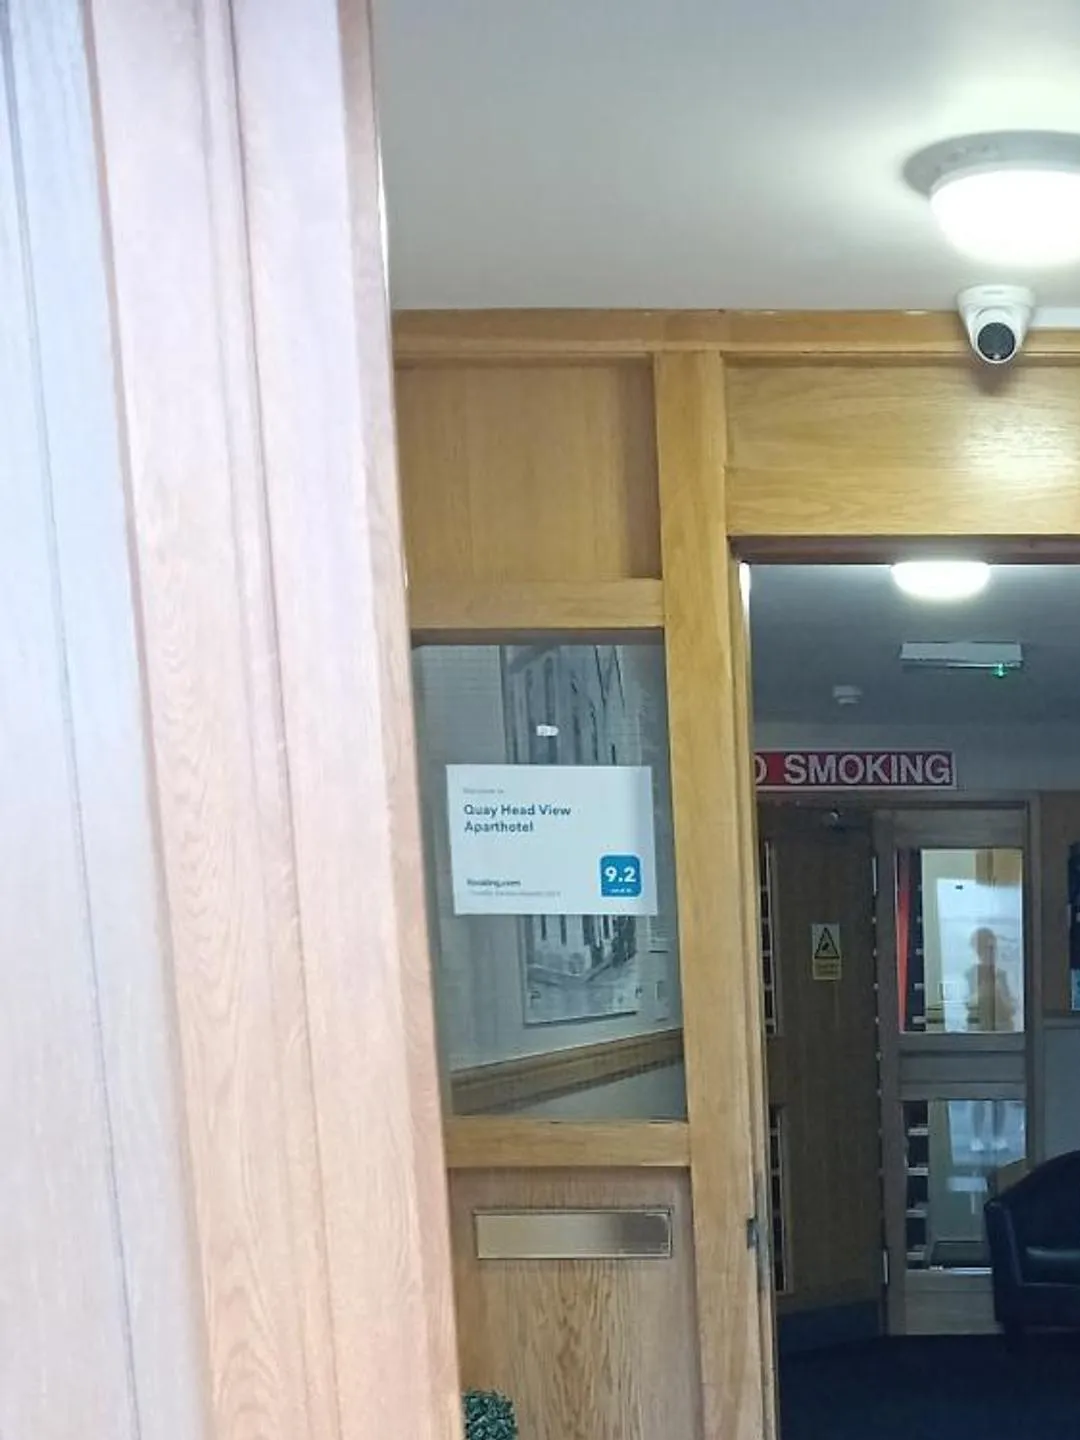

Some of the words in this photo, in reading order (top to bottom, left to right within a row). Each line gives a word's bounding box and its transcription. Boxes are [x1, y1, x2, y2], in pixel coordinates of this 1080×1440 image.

[784, 753, 950, 785] SMOKING
[463, 804, 498, 818] Quay
[501, 804, 536, 816] Head
[538, 804, 572, 816] View
[464, 820, 534, 835] Aparthotel
[604, 866, 637, 883] 9.2
